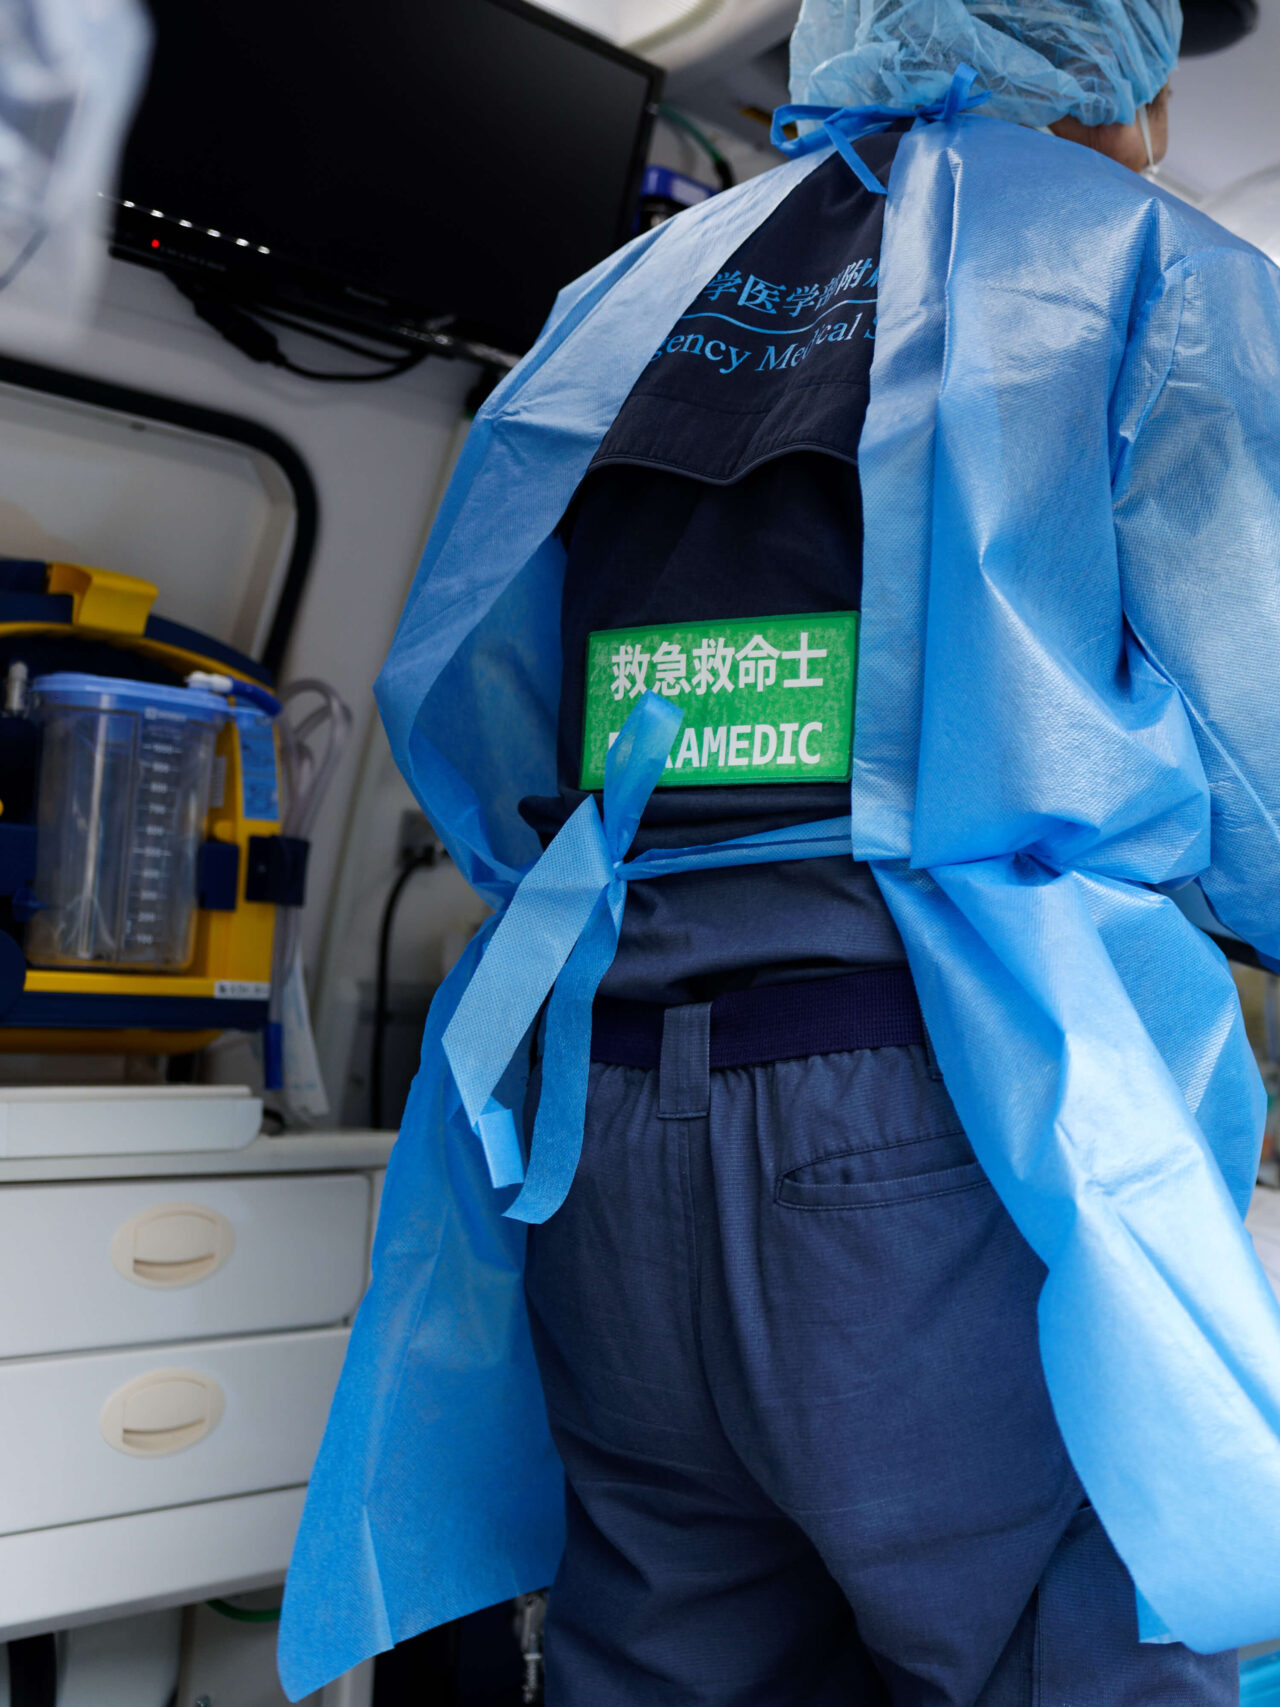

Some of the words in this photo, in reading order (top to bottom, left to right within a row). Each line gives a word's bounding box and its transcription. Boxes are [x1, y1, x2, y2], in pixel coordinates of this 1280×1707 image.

[610, 632, 827, 700] 救急救命士
[608, 721, 823, 769] AMEDIC
